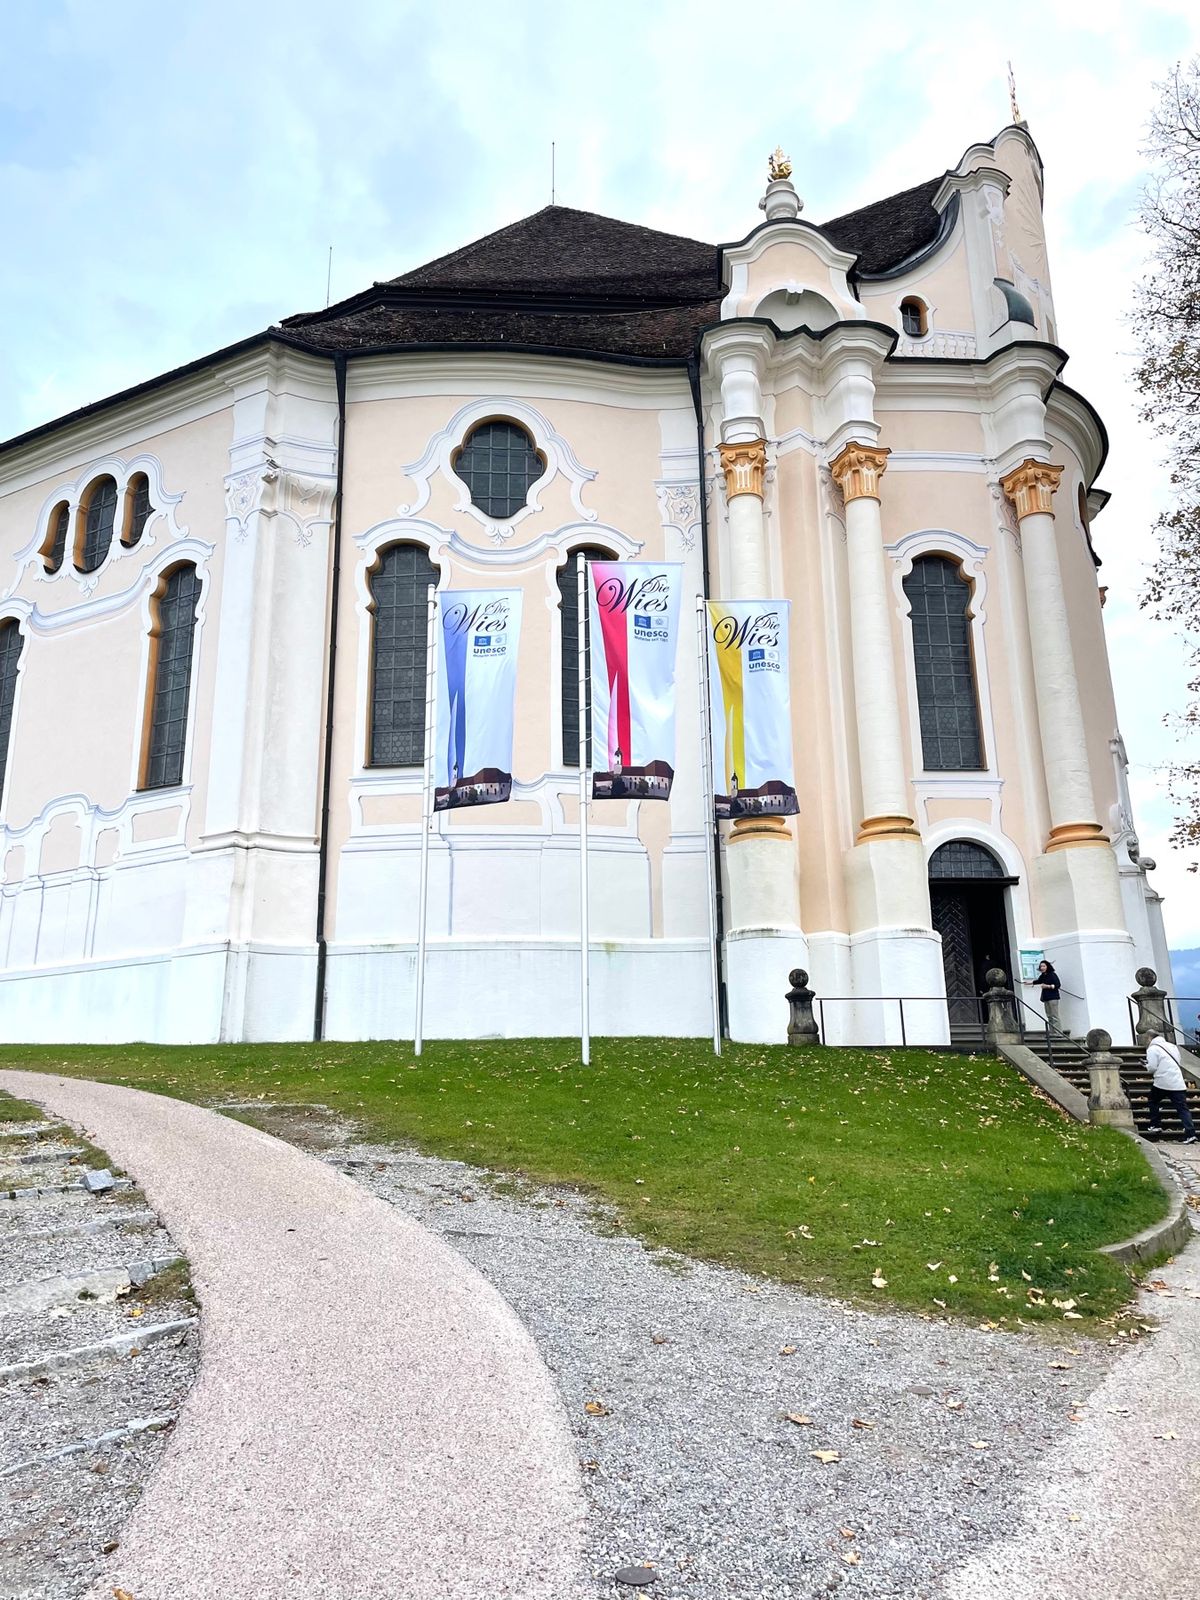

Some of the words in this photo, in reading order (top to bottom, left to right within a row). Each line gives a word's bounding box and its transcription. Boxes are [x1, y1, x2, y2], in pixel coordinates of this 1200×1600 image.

[596, 574, 669, 613] Wies
[641, 578, 670, 594] Die
[485, 601, 510, 616] Die
[442, 598, 509, 635] Wies
[754, 615, 780, 630] Die
[634, 629, 669, 638] unesco
[713, 612, 780, 650] Wies
[473, 646, 507, 654] unesco
[748, 661, 781, 670] unesco
